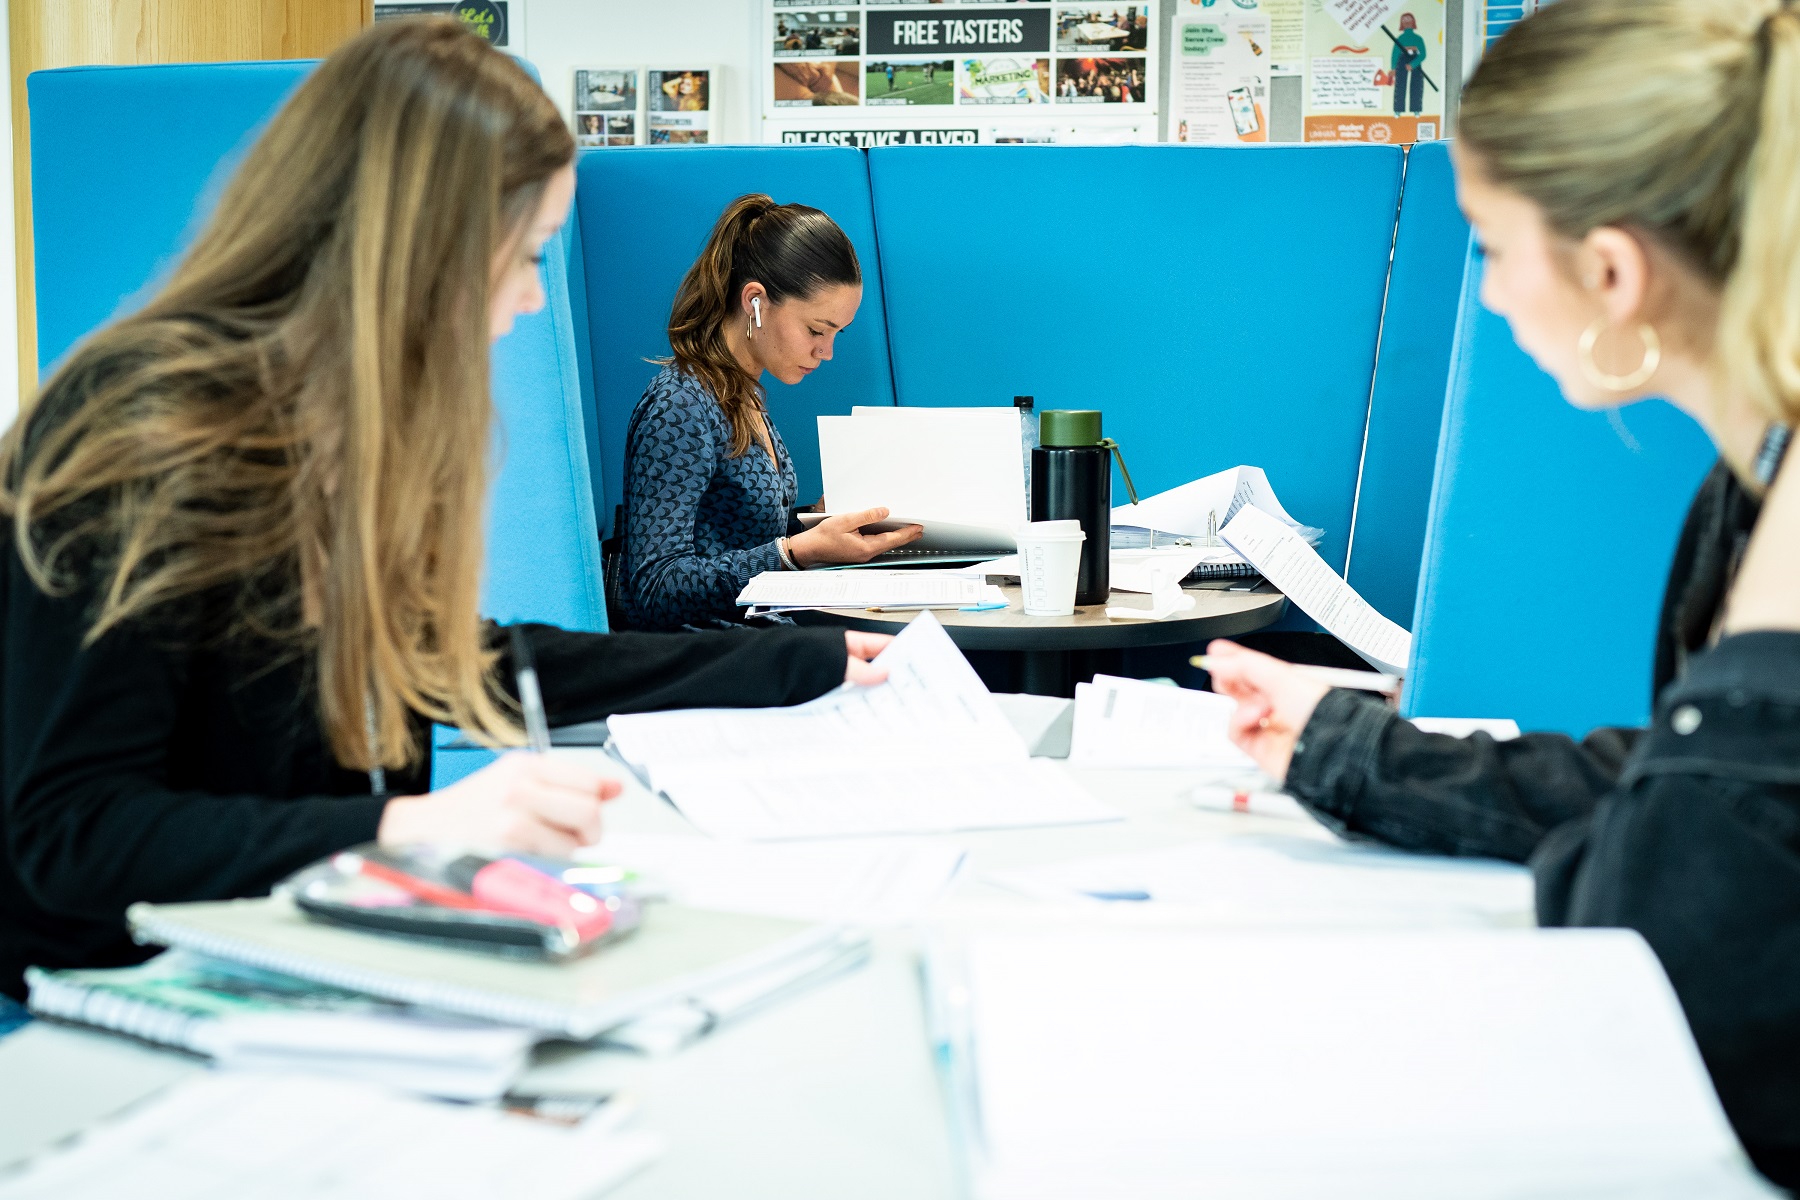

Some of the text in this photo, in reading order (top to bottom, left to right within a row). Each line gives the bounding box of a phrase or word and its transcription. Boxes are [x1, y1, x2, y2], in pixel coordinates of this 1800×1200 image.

[893, 18, 1024, 45] FREE TASTERS
[974, 69, 1032, 86] MARKETING
[784, 130, 975, 146] PLEASE TAKE A FLYER
